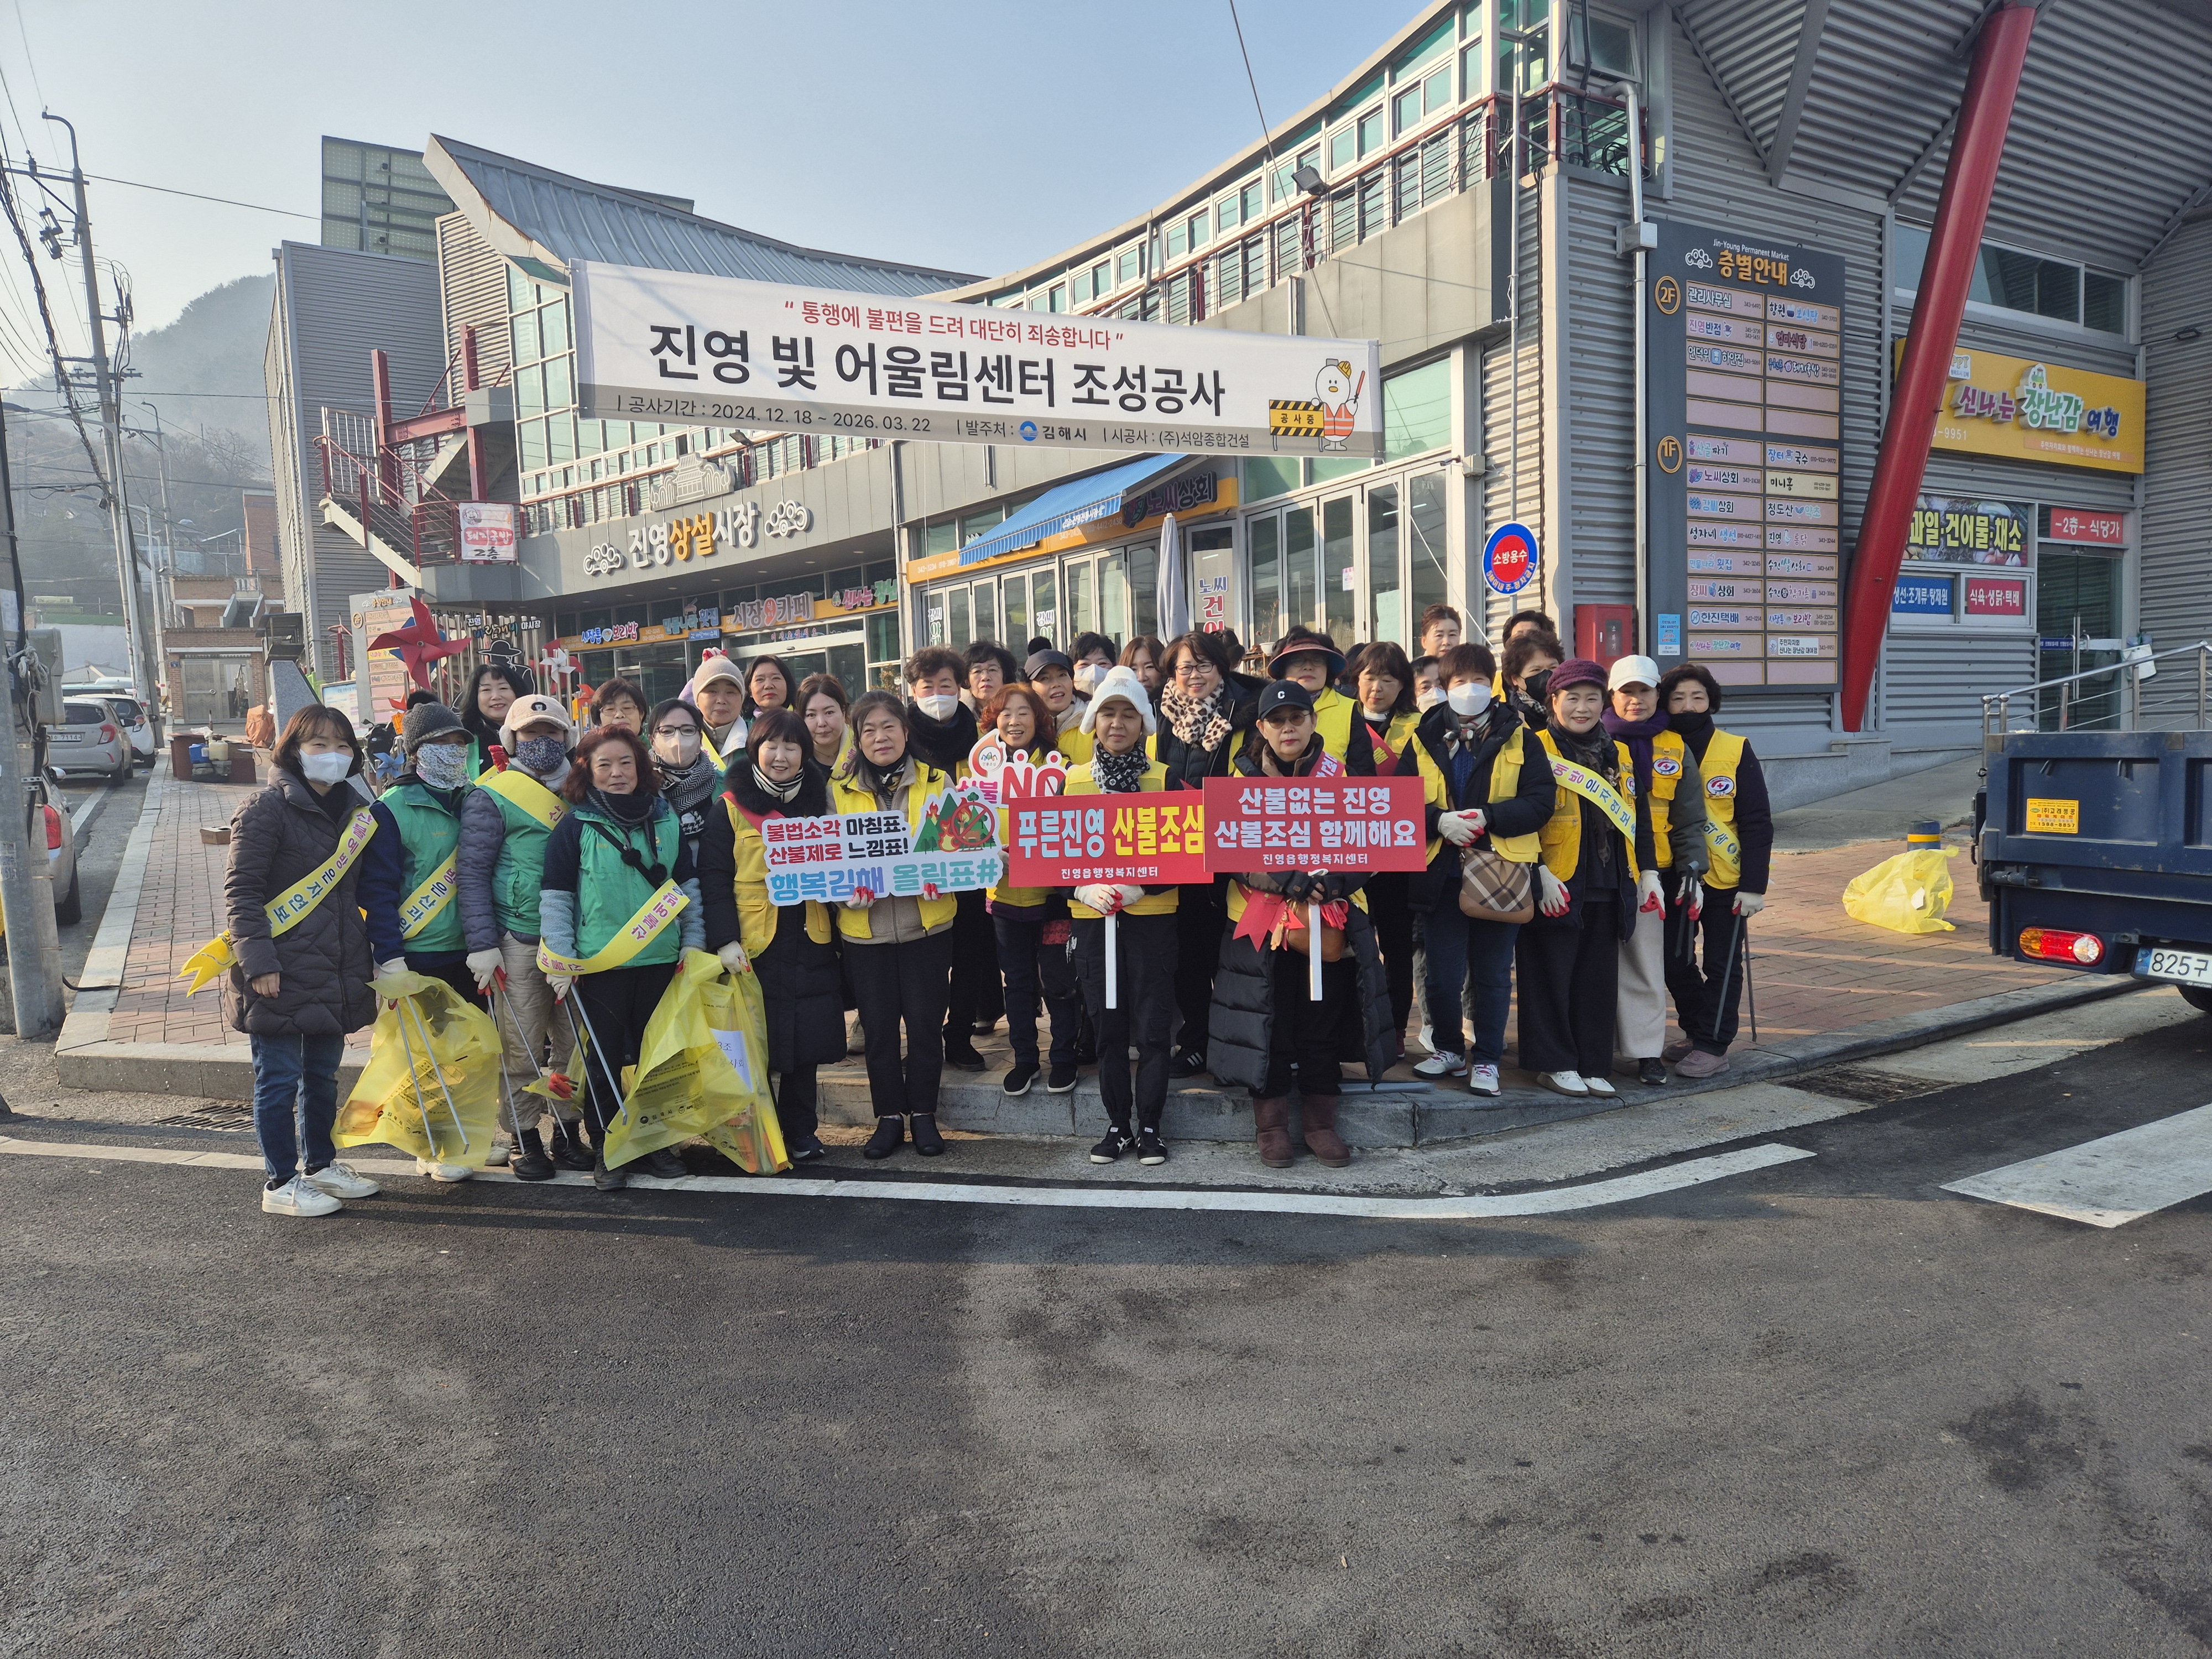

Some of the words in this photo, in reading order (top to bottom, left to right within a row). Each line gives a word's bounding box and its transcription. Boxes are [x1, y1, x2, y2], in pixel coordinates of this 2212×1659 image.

[1713, 239, 1740, 252] Jin-Young
[1742, 244, 1770, 257] Permanent
[1771, 251, 1790, 261] Market
[1718, 250, 1787, 286] 층별안내
[1660, 288, 1676, 303] 2F
[1688, 286, 1731, 309] 관리사무실
[1769, 301, 1785, 317] 향원
[1796, 307, 1818, 324] 보신탕
[802, 301, 860, 328] 통행에
[867, 307, 922, 334] 불편을
[929, 311, 964, 338] 드려
[970, 319, 1022, 344] 대단히
[1027, 324, 1111, 351] 죄송합니다
[1689, 319, 1721, 336] 진영반점
[1776, 330, 1807, 349] 엄마식당
[1688, 345, 1710, 363] 언덕위
[1721, 351, 1744, 367] 하얀집
[650, 325, 750, 384] 진영
[773, 336, 817, 392] 빛
[834, 343, 1055, 408] 어울림센터
[1072, 363, 1225, 416] 조성공사
[628, 397, 696, 418] 공사기간
[712, 403, 760, 422] 2024.
[766, 408, 789, 422] 12.
[794, 410, 812, 424] 18
[833, 411, 878, 429] 2026.
[883, 416, 907, 431] 03.
[912, 419, 931, 432] 22
[1959, 385, 2015, 420] 신나는
[2024, 388, 2082, 431] 장난감
[2086, 408, 2119, 438] 여행
[966, 421, 1006, 438] 발주처
[1042, 425, 1086, 441] 김해시
[1112, 428, 1148, 445] 시공사
[1159, 431, 1250, 448] (주)석암종합건설
[1661, 442, 1676, 457] 1F
[1697, 442, 1728, 458] 산골짜기
[1768, 449, 1783, 462] 장터
[2085, 447, 2098, 457] 신나는
[2099, 450, 2111, 459] 장난감
[1795, 451, 1808, 465] 국수
[1704, 469, 1739, 484] 노씨상회
[1771, 477, 1793, 491] 미니홍
[1146, 471, 1213, 517] 노씨상회
[1768, 503, 1793, 517] 청도산
[1804, 505, 1822, 519] 약초
[629, 502, 758, 568] 진영상설시장
[1690, 526, 1717, 540] 성자네
[1719, 528, 1736, 542] 생선
[2090, 519, 2120, 539] 식당가
[466, 530, 513, 545] 돼지국밥
[1768, 531, 1781, 544] 진영
[1794, 533, 1807, 546] 통닭
[473, 546, 500, 559] 2층
[1493, 549, 1527, 565] 소방용수
[1689, 559, 1714, 569] 민물나라
[1717, 559, 1732, 571] 횟집
[1199, 576, 1227, 594] 노씨
[1690, 585, 1707, 597] 장씨
[1718, 585, 1734, 597] 상회
[1789, 584, 1809, 600] 참기름
[842, 586, 873, 610] 신나는
[733, 601, 763, 629] 시장
[776, 593, 811, 623] 카페
[928, 607, 942, 622] 강씨
[1036, 609, 1055, 627] 강씨
[1701, 612, 1739, 624] 한진택배
[1768, 613, 1785, 625] 시장통
[521, 620, 541, 629] 야시장
[662, 614, 698, 635] 민물나라
[698, 608, 719, 628] 횟집
[1793, 613, 1812, 627] 보리밥
[582, 627, 602, 644] 시장통
[612, 621, 638, 641] 보리밥
[1695, 641, 1711, 651] 신나는
[1713, 640, 1730, 651] 장난감
[1730, 641, 1741, 651] 여행
[1001, 766, 1066, 804] NO
[1238, 787, 1335, 816] 산불없는
[1342, 787, 1391, 814] 진영
[767, 820, 841, 842] 불법소각
[846, 816, 907, 836] 마침표.
[1019, 810, 1105, 859] 푸른진영
[1113, 805, 1203, 856] 산불조심
[1214, 820, 1311, 848] 산불조심
[1319, 820, 1416, 848] 함께해요
[769, 843, 842, 865] 산불제로
[848, 836, 909, 859] 느낌표!
[1263, 853, 1368, 866] 진영읍행정복지센터
[770, 867, 885, 902] 행복김해
[893, 858, 998, 892] 올림표#
[1061, 865, 1159, 880] 진영읍행정복지센터
[717, 1041, 732, 1051] 3조
